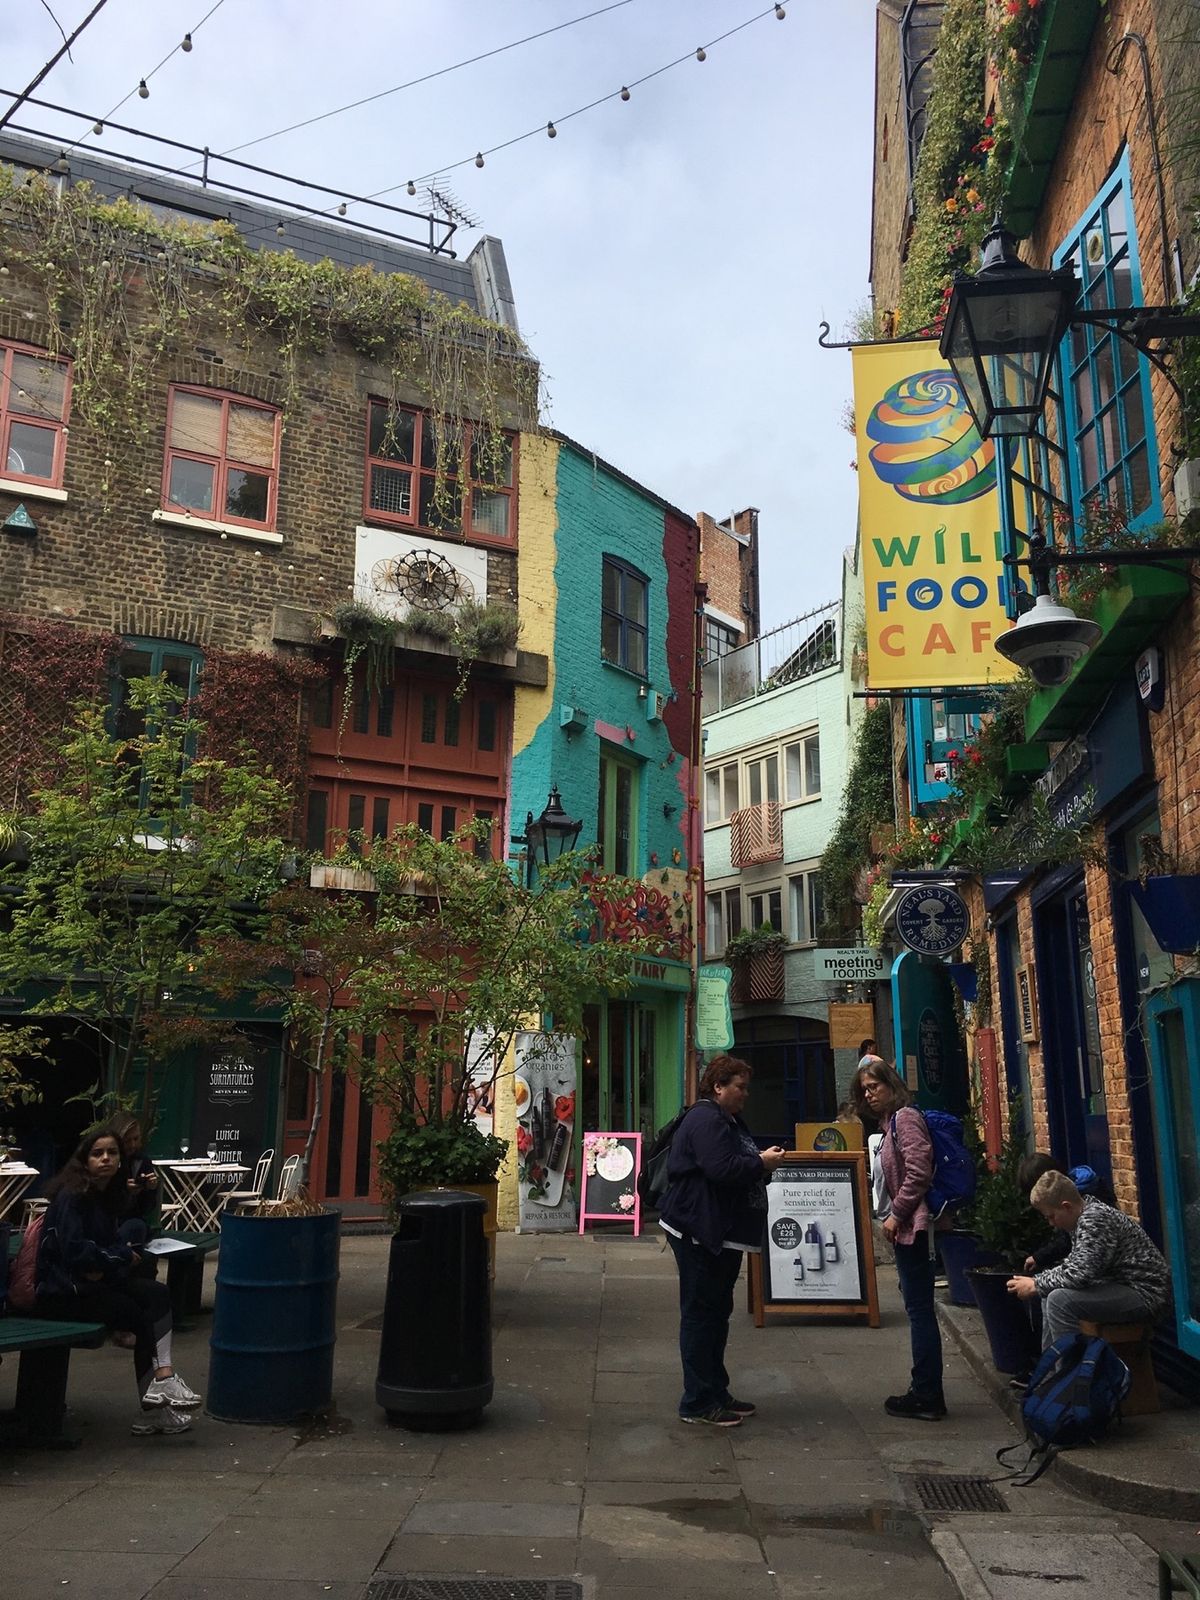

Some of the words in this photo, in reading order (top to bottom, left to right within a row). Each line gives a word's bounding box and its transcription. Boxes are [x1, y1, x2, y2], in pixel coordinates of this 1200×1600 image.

[878, 621, 1018, 657] CAF
[901, 888, 934, 918] NEAL'S
[937, 889, 963, 916] YARD
[902, 918, 923, 926] COVENT
[904, 925, 963, 950] REMEDIES
[824, 955, 884, 971] meeting
[634, 962, 667, 981] FAIRY
[833, 967, 876, 978] rooms
[526, 1052, 565, 1062] msters
[234, 1063, 255, 1071] INS
[210, 1073, 254, 1086] SURNATURELS
[216, 1129, 240, 1141] LUNCH
[778, 1170, 798, 1179] NEAL'S
[799, 1170, 816, 1178] YARD
[817, 1170, 849, 1178] REMEDIES
[783, 1188, 801, 1197] Pure
[804, 1187, 823, 1197] relief
[824, 1187, 837, 1197] for
[784, 1198, 816, 1207] sensitive
[819, 1198, 836, 1207] skin
[524, 1212, 543, 1220] REPAIR
[548, 1211, 571, 1219] RESTORE
